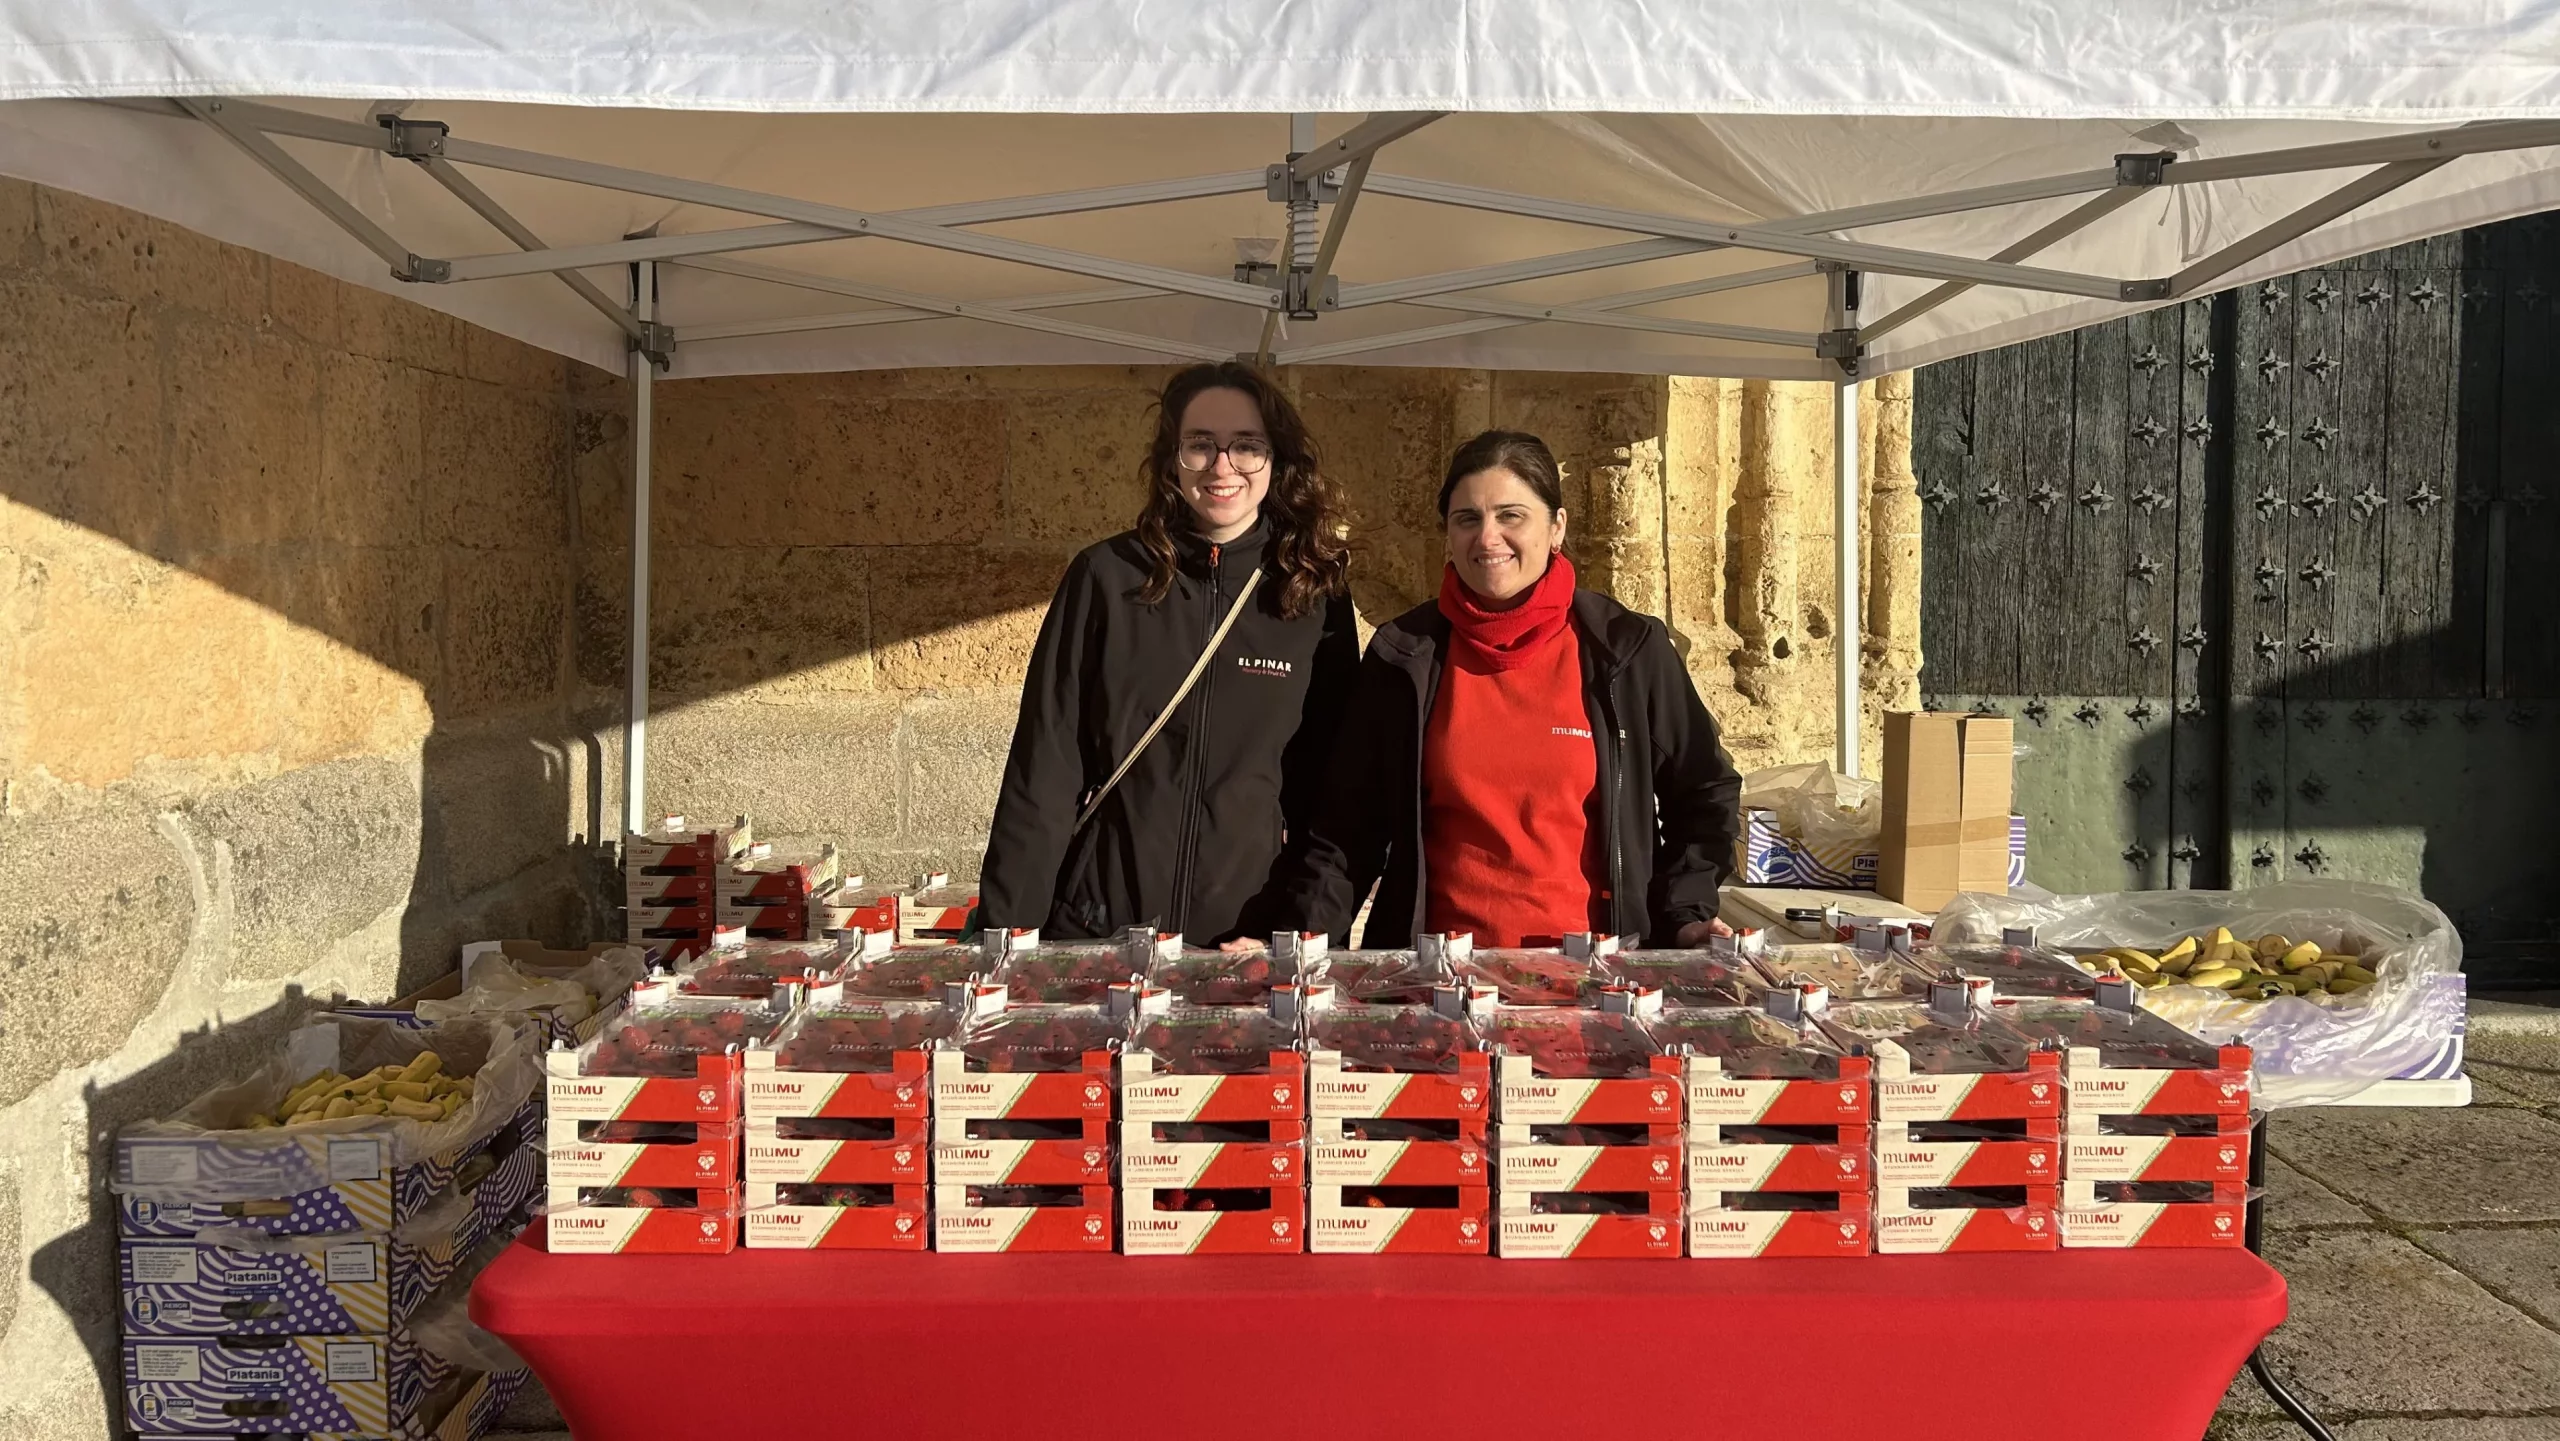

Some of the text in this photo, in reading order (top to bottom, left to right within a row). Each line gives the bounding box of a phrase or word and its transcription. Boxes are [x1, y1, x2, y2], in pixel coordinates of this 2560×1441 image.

[1238, 657, 1292, 672] EL PINAR
[1551, 727, 1591, 739] muMU
[1857, 858, 1879, 868] Plat
[552, 1085, 603, 1095] muMU
[751, 1083, 802, 1094] muMU
[940, 1083, 990, 1094] muMU
[1316, 1083, 1366, 1093] muMU
[1886, 1083, 1936, 1094] muMU
[2074, 1081, 2125, 1091] muMU
[1129, 1087, 1179, 1097] muMU
[1694, 1087, 1745, 1097] muMU
[749, 1147, 800, 1157] muMU
[940, 1149, 989, 1159] muMU
[1316, 1148, 1366, 1158] muMU
[2073, 1146, 2124, 1156] muMU
[1127, 1155, 1178, 1165] muMU
[1506, 1157, 1557, 1167] muMU
[1694, 1156, 1745, 1166] muMU
[1883, 1152, 1934, 1163] muMU
[554, 1218, 605, 1229] muMU
[751, 1214, 801, 1224] muMU
[941, 1218, 991, 1228] muMU
[2068, 1213, 2119, 1224] muMU
[453, 1211, 481, 1243] Platania
[1128, 1220, 1178, 1230] muMU
[1316, 1219, 1366, 1229] muMU
[1504, 1223, 1554, 1233] muMU
[1695, 1221, 1745, 1232] muMU
[228, 1272, 278, 1282] Platania
[230, 1370, 280, 1379] Platania
